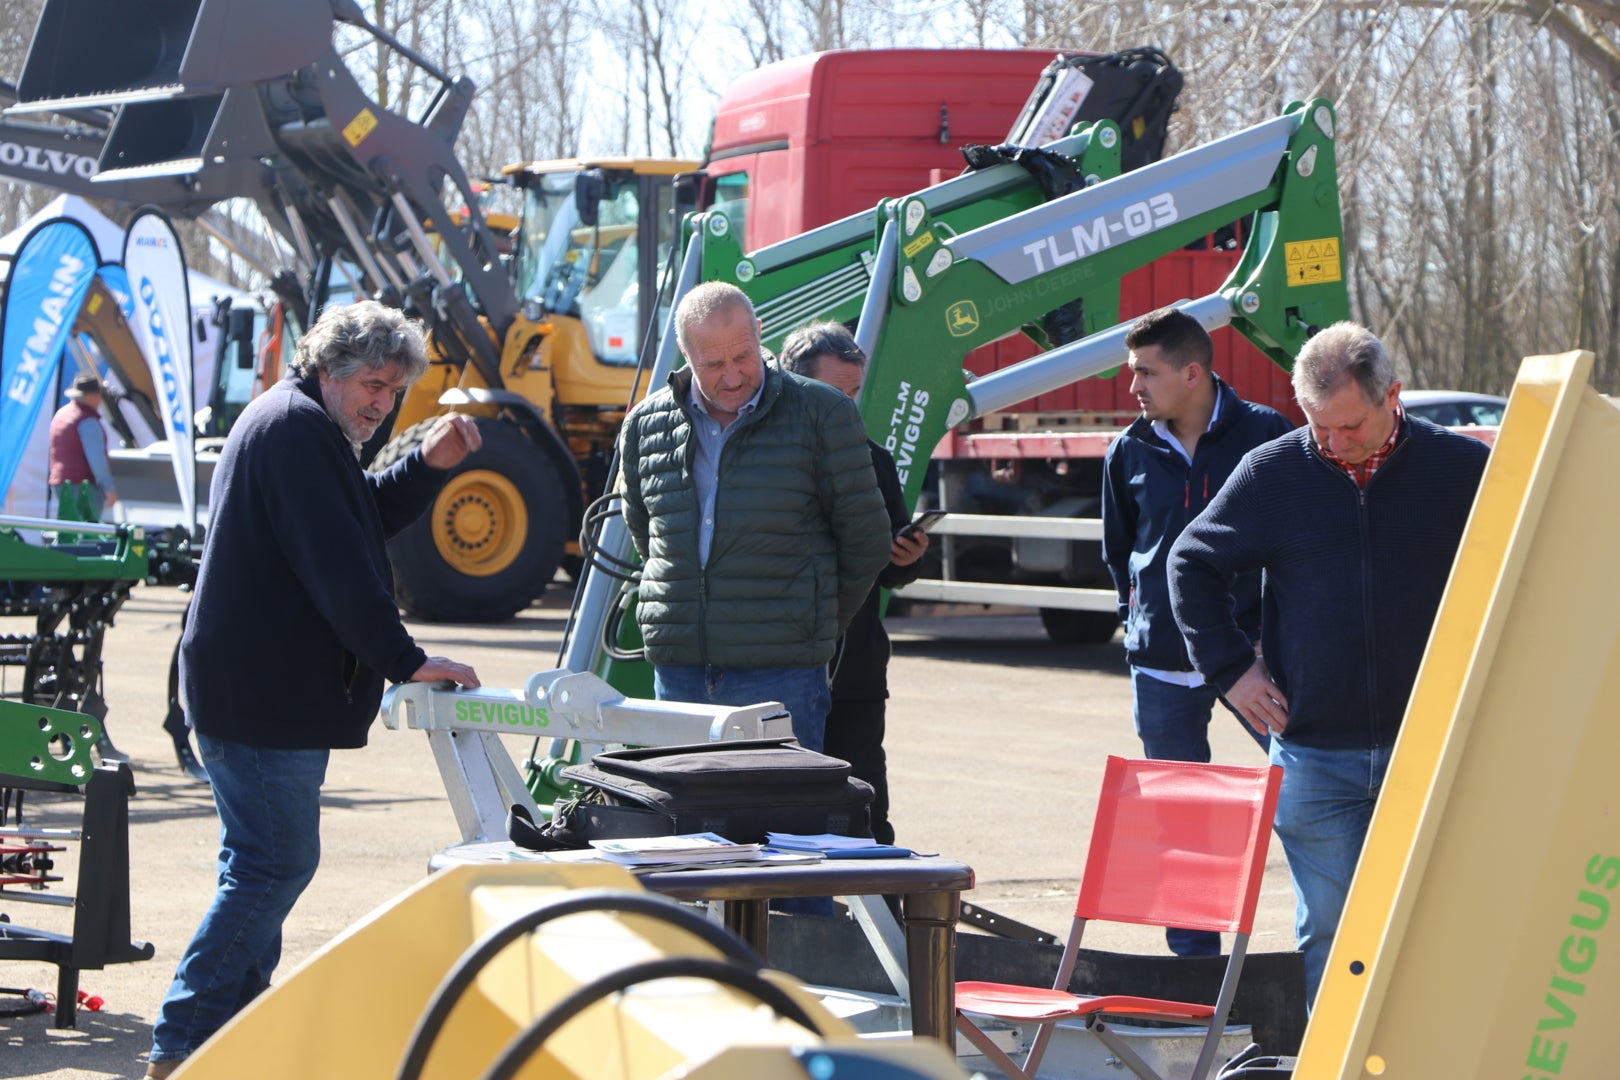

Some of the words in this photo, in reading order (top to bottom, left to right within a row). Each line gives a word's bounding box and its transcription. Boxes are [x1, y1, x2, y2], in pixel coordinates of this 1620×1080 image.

[0, 141, 99, 179] OLVO
[1022, 192, 1179, 274] TLM-03
[984, 287, 1033, 318] JOHN
[1035, 262, 1096, 297] DEERE
[8, 253, 85, 406] EXMAIN
[885, 381, 911, 456] O-TLM
[896, 389, 930, 493] EVIGUS
[455, 700, 551, 728] SEVIGUS
[1520, 853, 1620, 1080] EVIGUS
